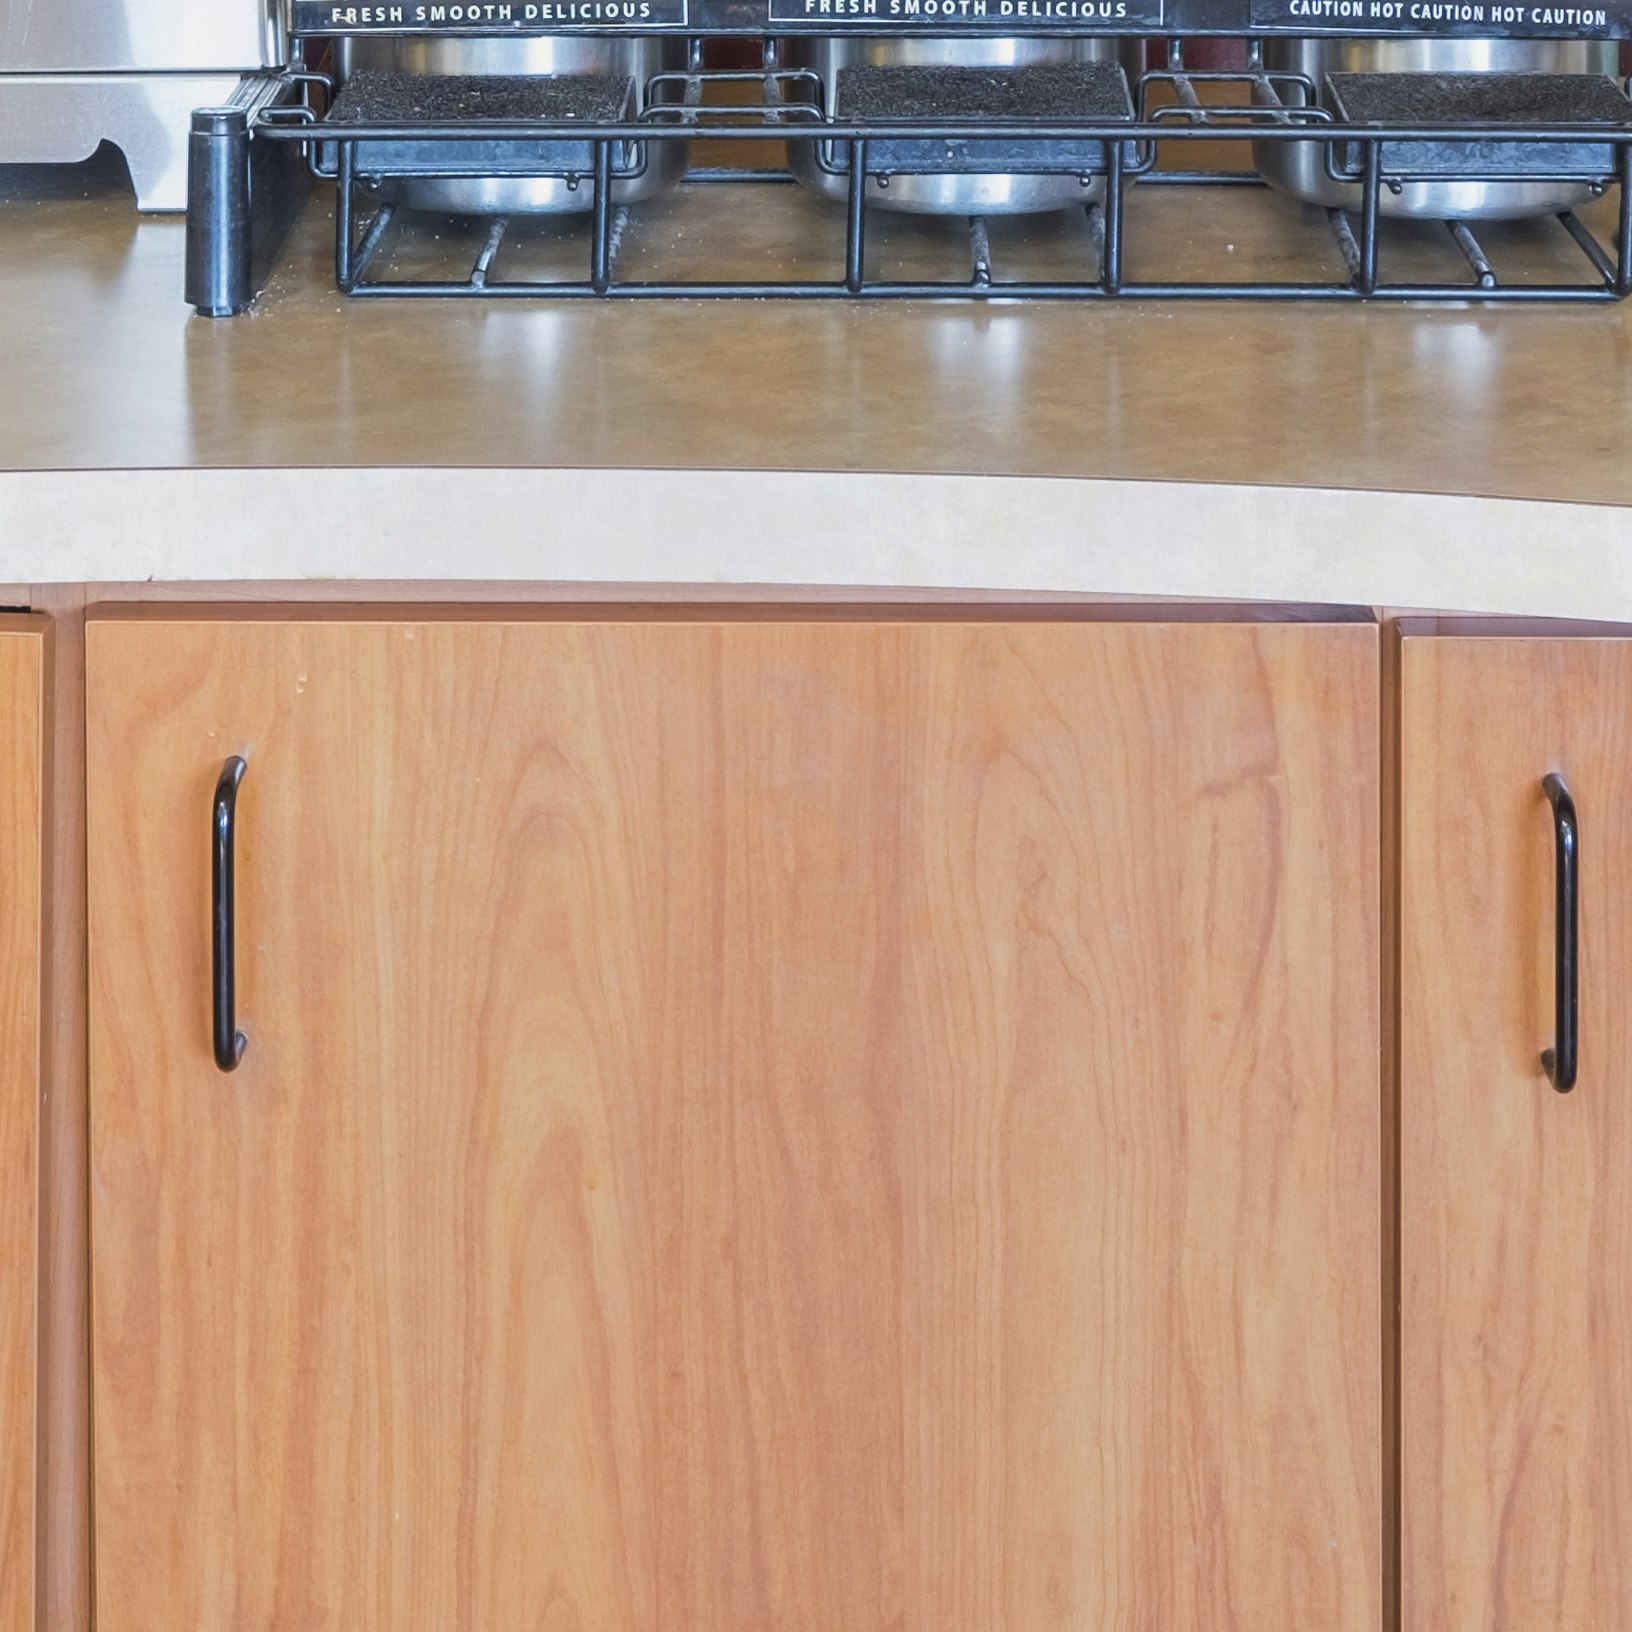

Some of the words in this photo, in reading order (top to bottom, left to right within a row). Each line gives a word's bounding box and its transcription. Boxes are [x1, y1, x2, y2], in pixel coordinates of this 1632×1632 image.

[331, 7, 403, 24] FRESH
[415, 4, 512, 21] SMOOTH
[525, 1, 651, 20] DELICIOUS
[890, 0, 987, 17] SMOOTH
[999, 0, 1128, 18] DELICIOUS
[1370, 1, 1404, 18] HOT
[1410, 3, 1485, 22] CAUTION
[1491, 6, 1525, 24] HOT
[1532, 8, 1607, 26] CAUTION
